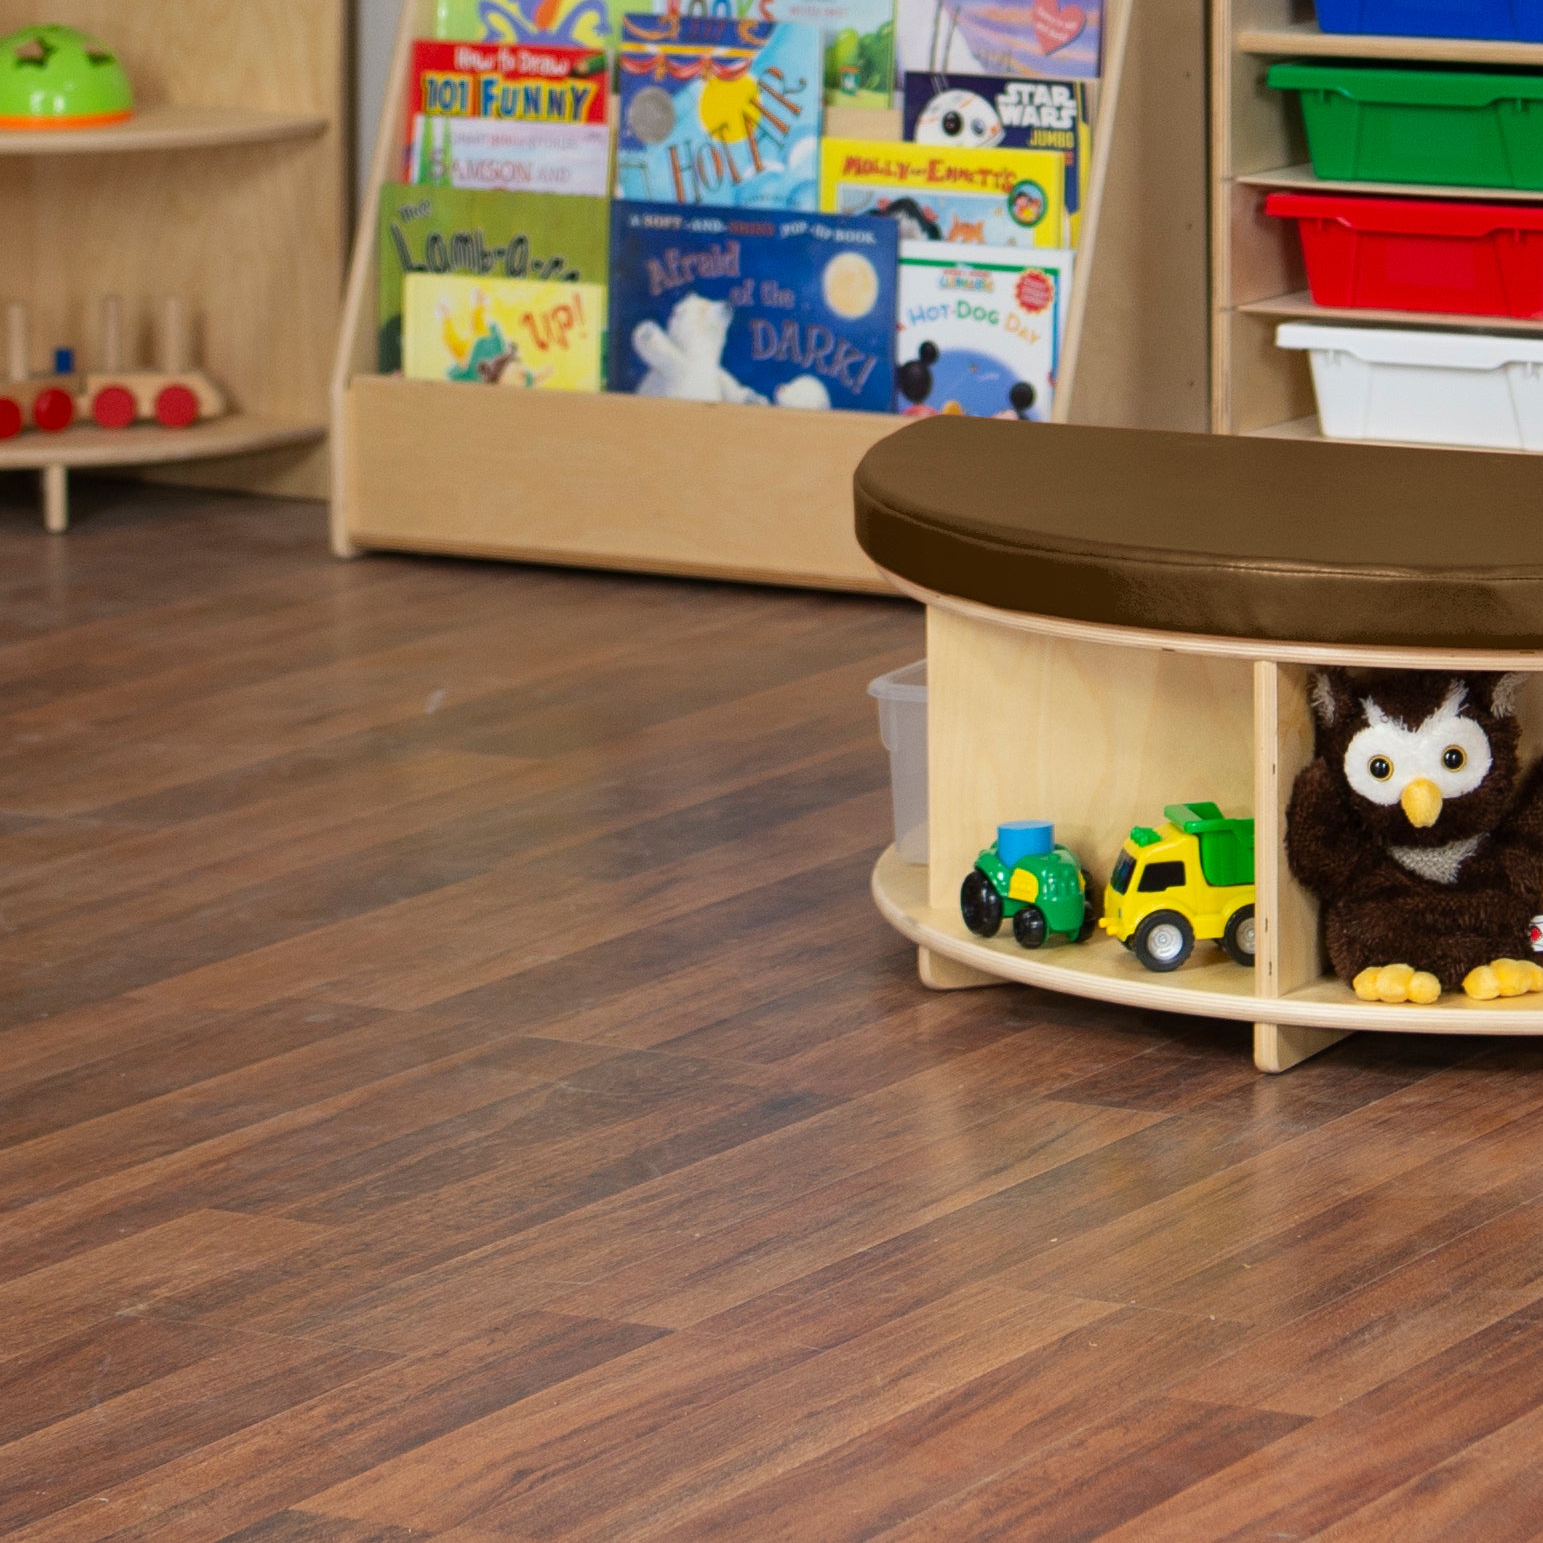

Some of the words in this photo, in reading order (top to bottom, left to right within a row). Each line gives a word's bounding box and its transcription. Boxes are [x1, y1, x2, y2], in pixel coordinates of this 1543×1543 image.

[498, 48, 516, 72] to
[426, 77, 470, 112] 101
[481, 77, 592, 121] FUNNY
[996, 81, 1077, 108] STAR
[998, 105, 1077, 129] WARS
[1029, 130, 1074, 148] JUMBO
[843, 155, 910, 181] MOLLY
[645, 239, 741, 296] Afraid
[729, 278, 755, 306] of
[760, 280, 795, 308] the
[908, 303, 950, 325] HOT
[956, 300, 1000, 325] DOG
[1004, 312, 1041, 345] DAY
[750, 317, 878, 395] DARK!
